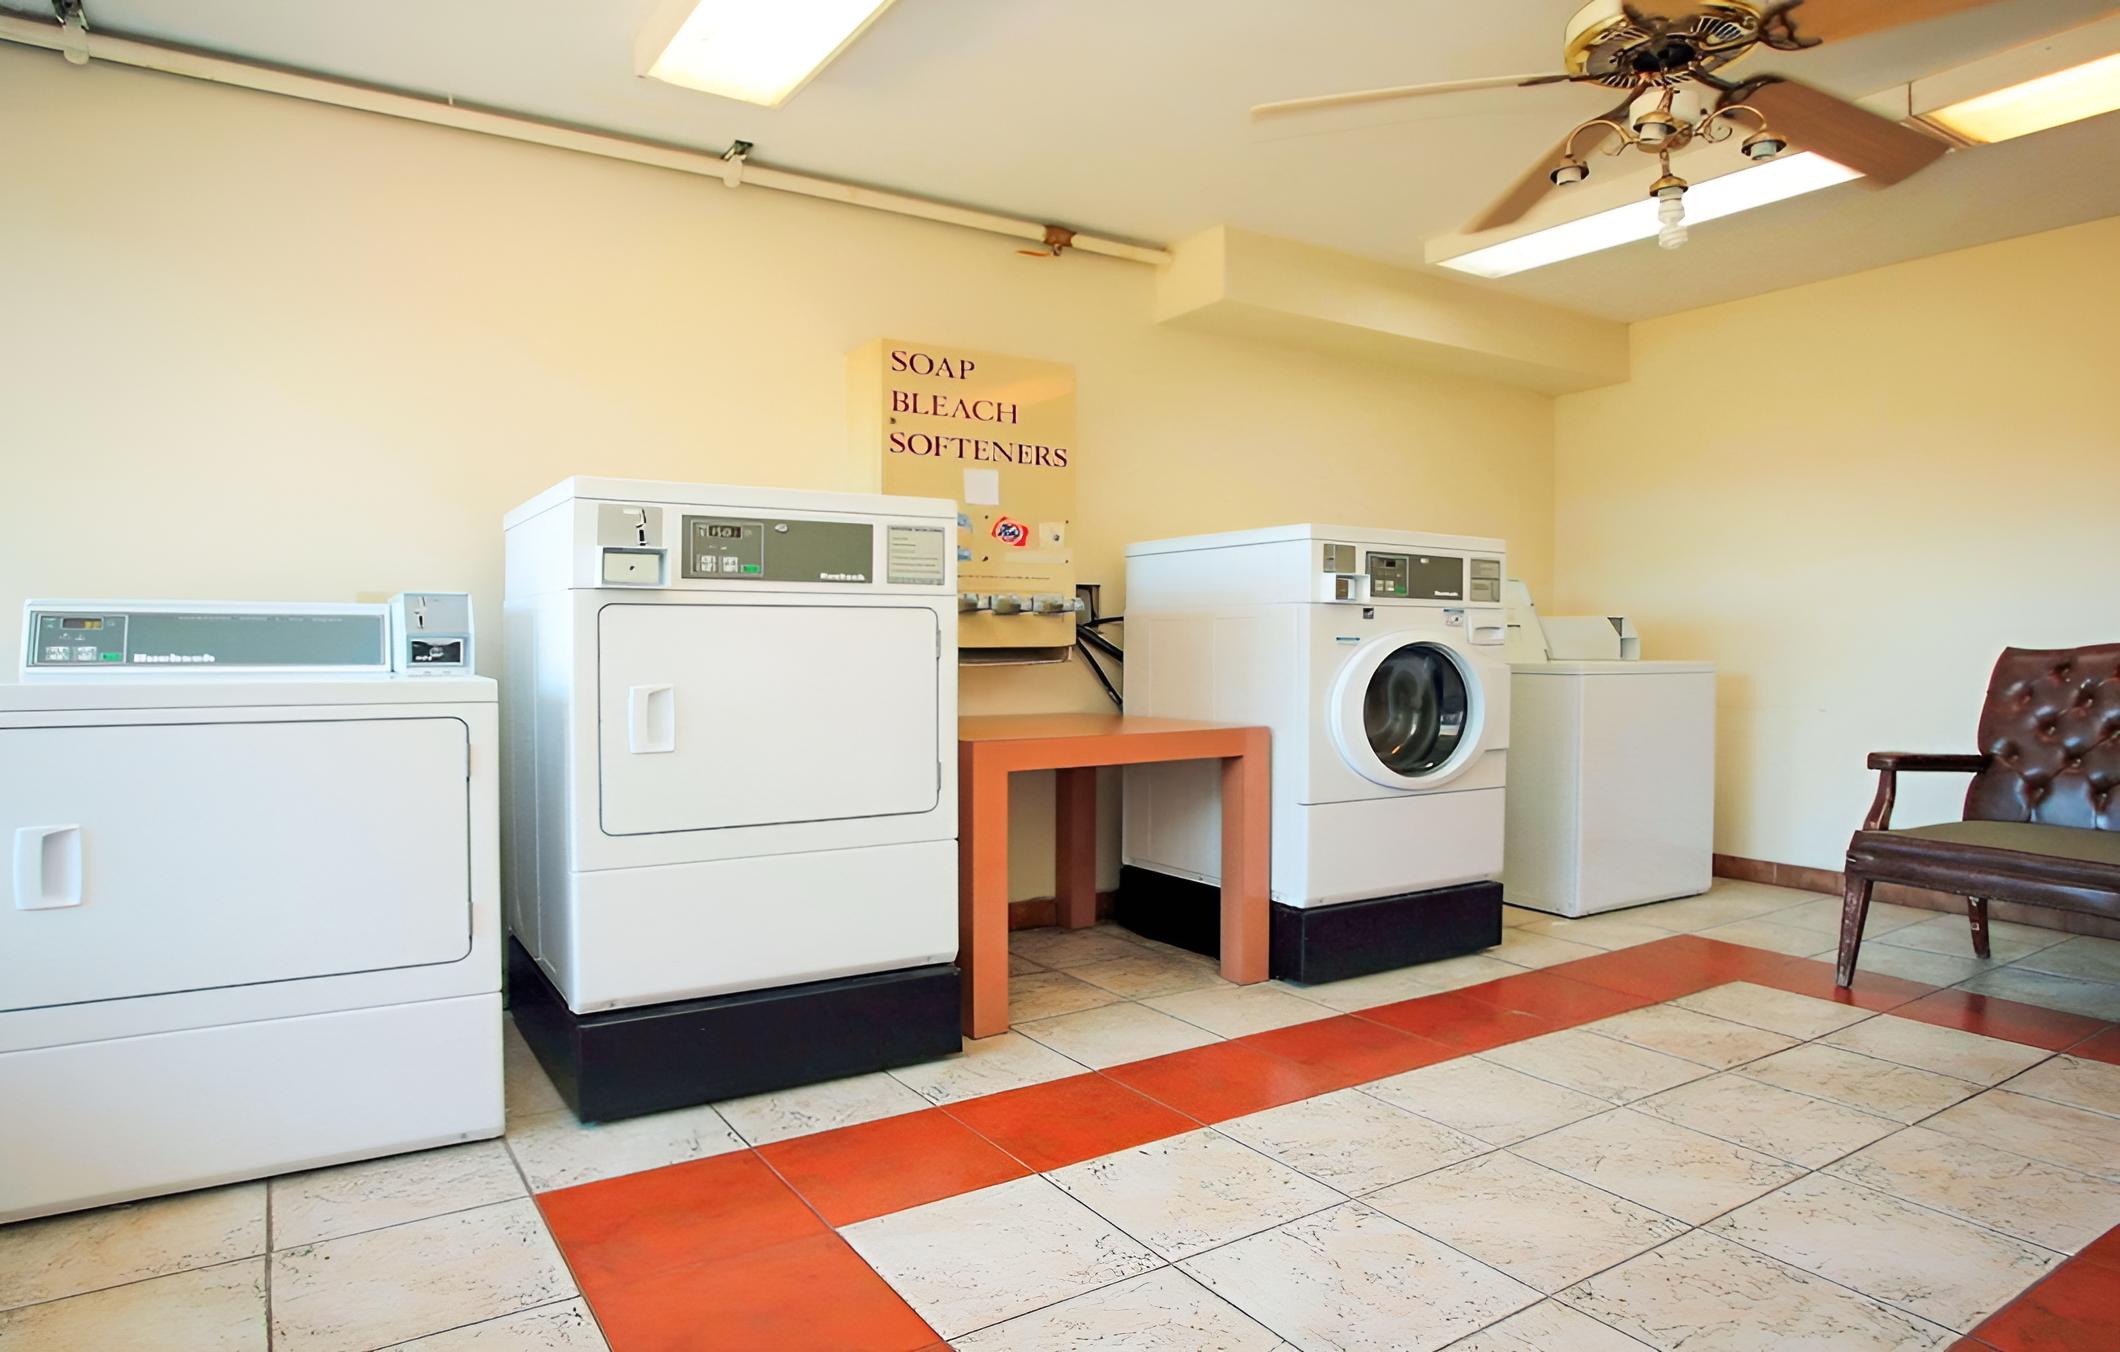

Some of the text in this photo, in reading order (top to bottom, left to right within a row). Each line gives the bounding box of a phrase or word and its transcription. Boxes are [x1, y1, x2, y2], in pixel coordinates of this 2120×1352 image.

[891, 350, 975, 380] SOAP
[891, 390, 1018, 424] BLEACH
[889, 432, 1068, 468] SOFTENERS
